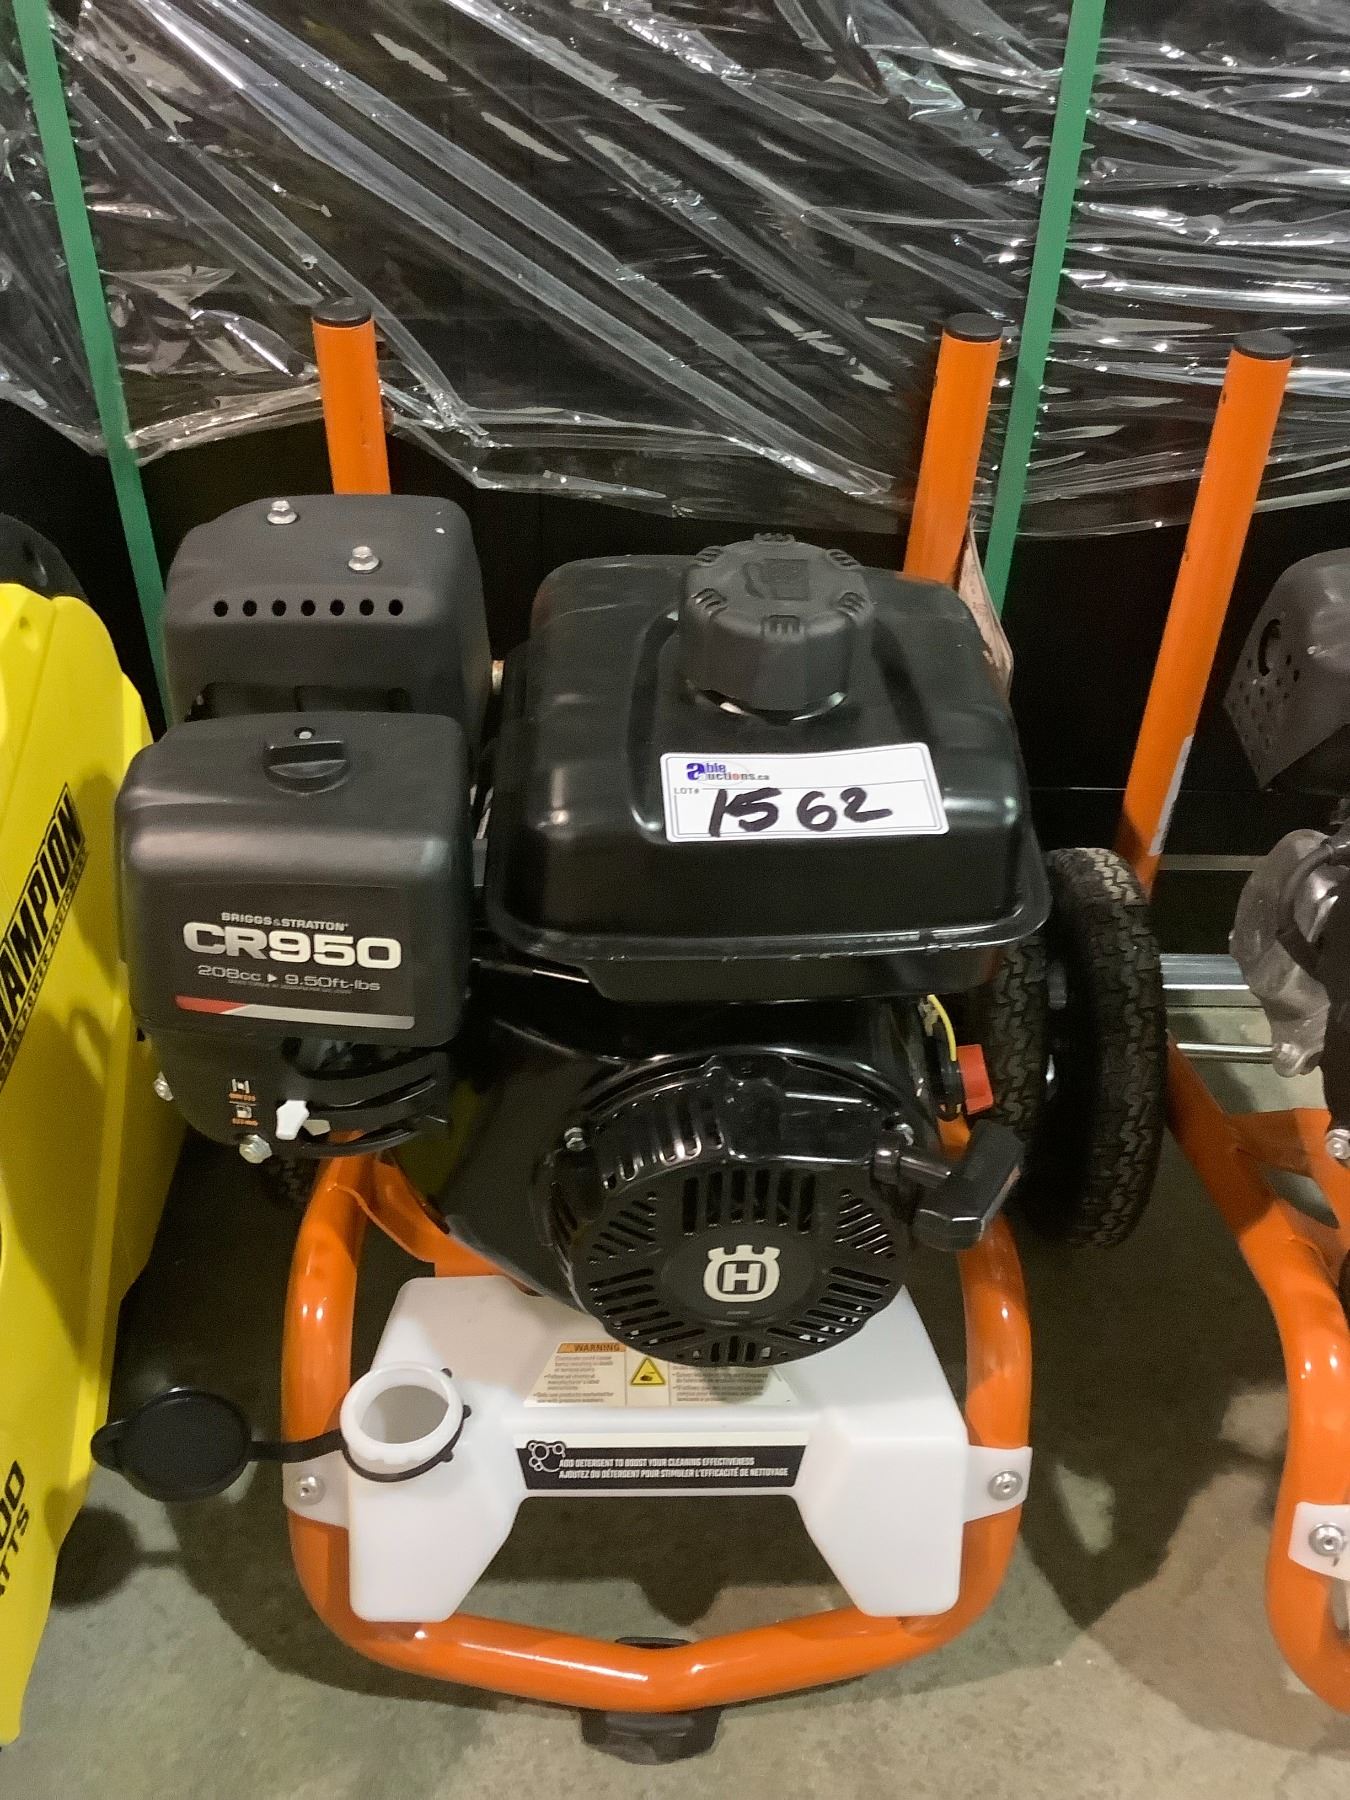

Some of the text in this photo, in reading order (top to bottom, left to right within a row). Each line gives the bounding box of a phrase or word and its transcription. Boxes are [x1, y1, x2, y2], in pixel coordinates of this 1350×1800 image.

[708, 787, 893, 837] 1562
[183, 921, 402, 970] CR950
[198, 964, 262, 981] 208cc
[284, 974, 381, 991] 9.50ft-lbs
[575, 1343, 620, 1352] WARNING
[575, 1458, 613, 1467] DETERGENT
[615, 1458, 624, 1467] TO
[648, 1458, 668, 1466] YOUR
[668, 1458, 701, 1466] CLEANING
[702, 1457, 754, 1466] EFFECTIVENESS
[559, 1470, 590, 1478] AJOUTEZ
[641, 1469, 660, 1478] POUR
[660, 1469, 694, 1478] STIMULER
[740, 1468, 750, 1477] DE
[750, 1467, 788, 1477] NETTOYAGE
